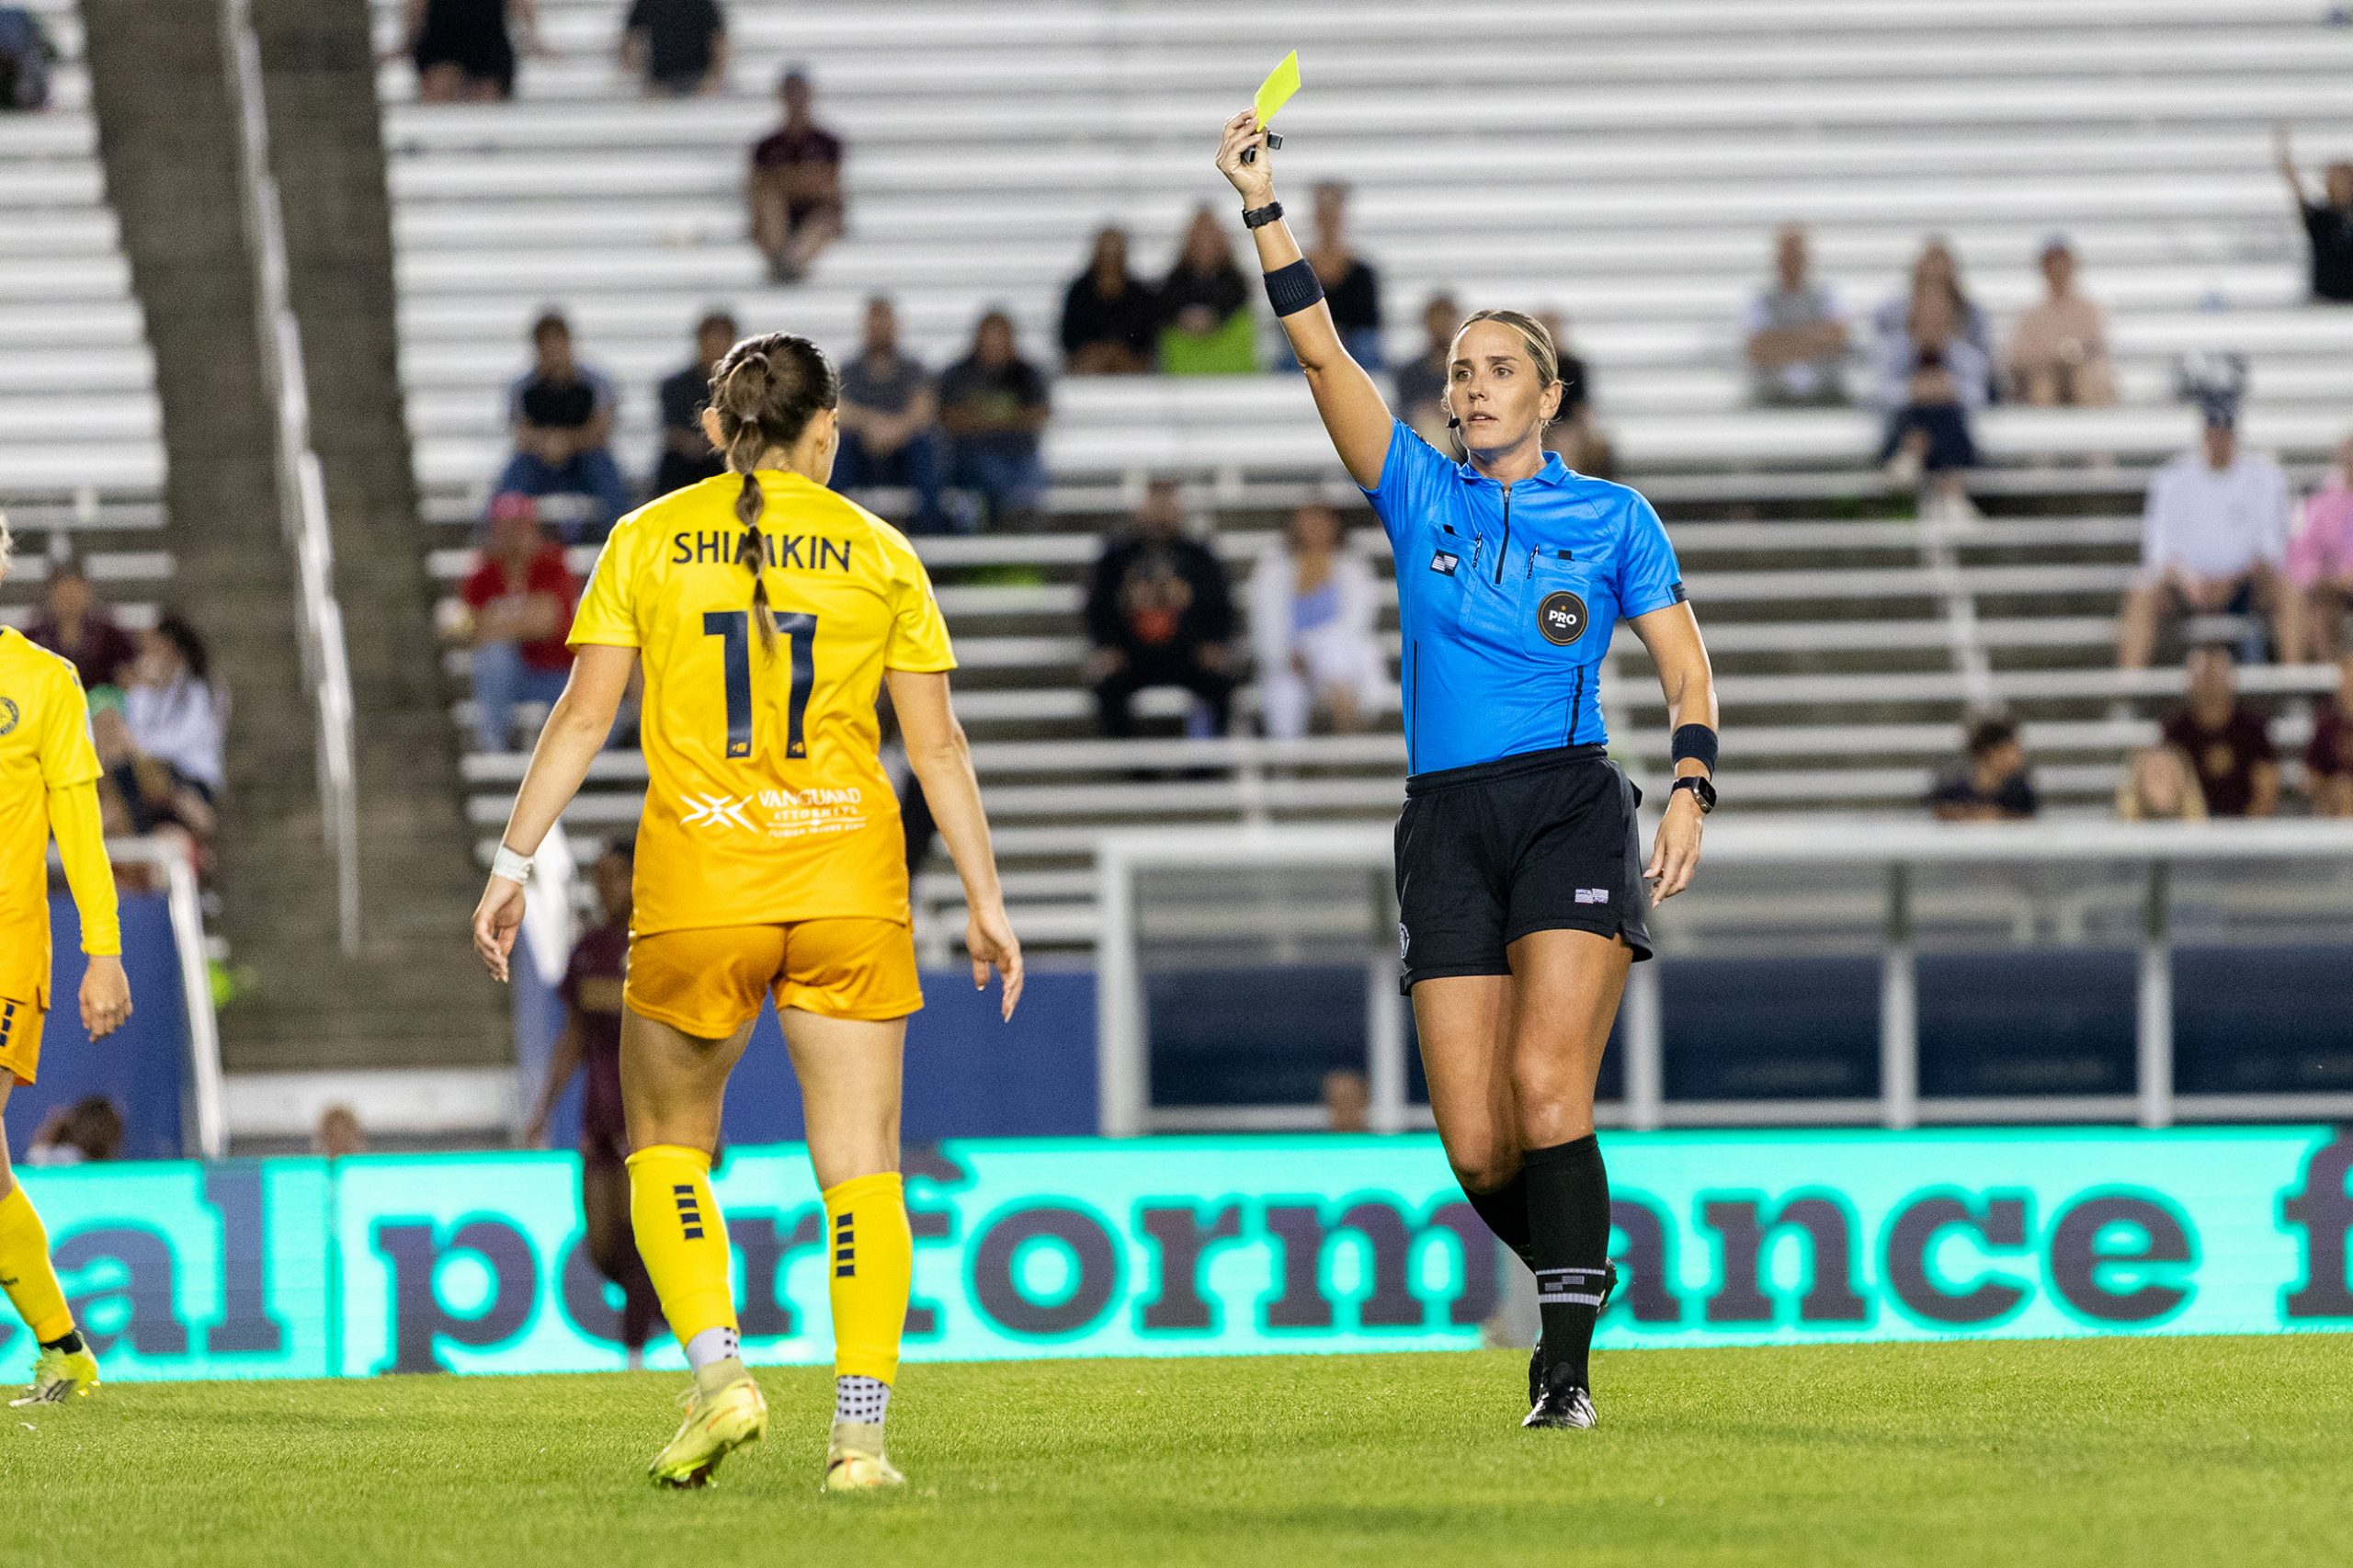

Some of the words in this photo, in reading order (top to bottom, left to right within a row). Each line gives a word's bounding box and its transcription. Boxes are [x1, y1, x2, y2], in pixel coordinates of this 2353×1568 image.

[1549, 609, 1577, 625] PRO
[703, 609, 817, 758] 11
[757, 788, 862, 809] VANGUARD
[773, 805, 858, 821] ATTORNEYS
[0, 1157, 281, 1354] al
